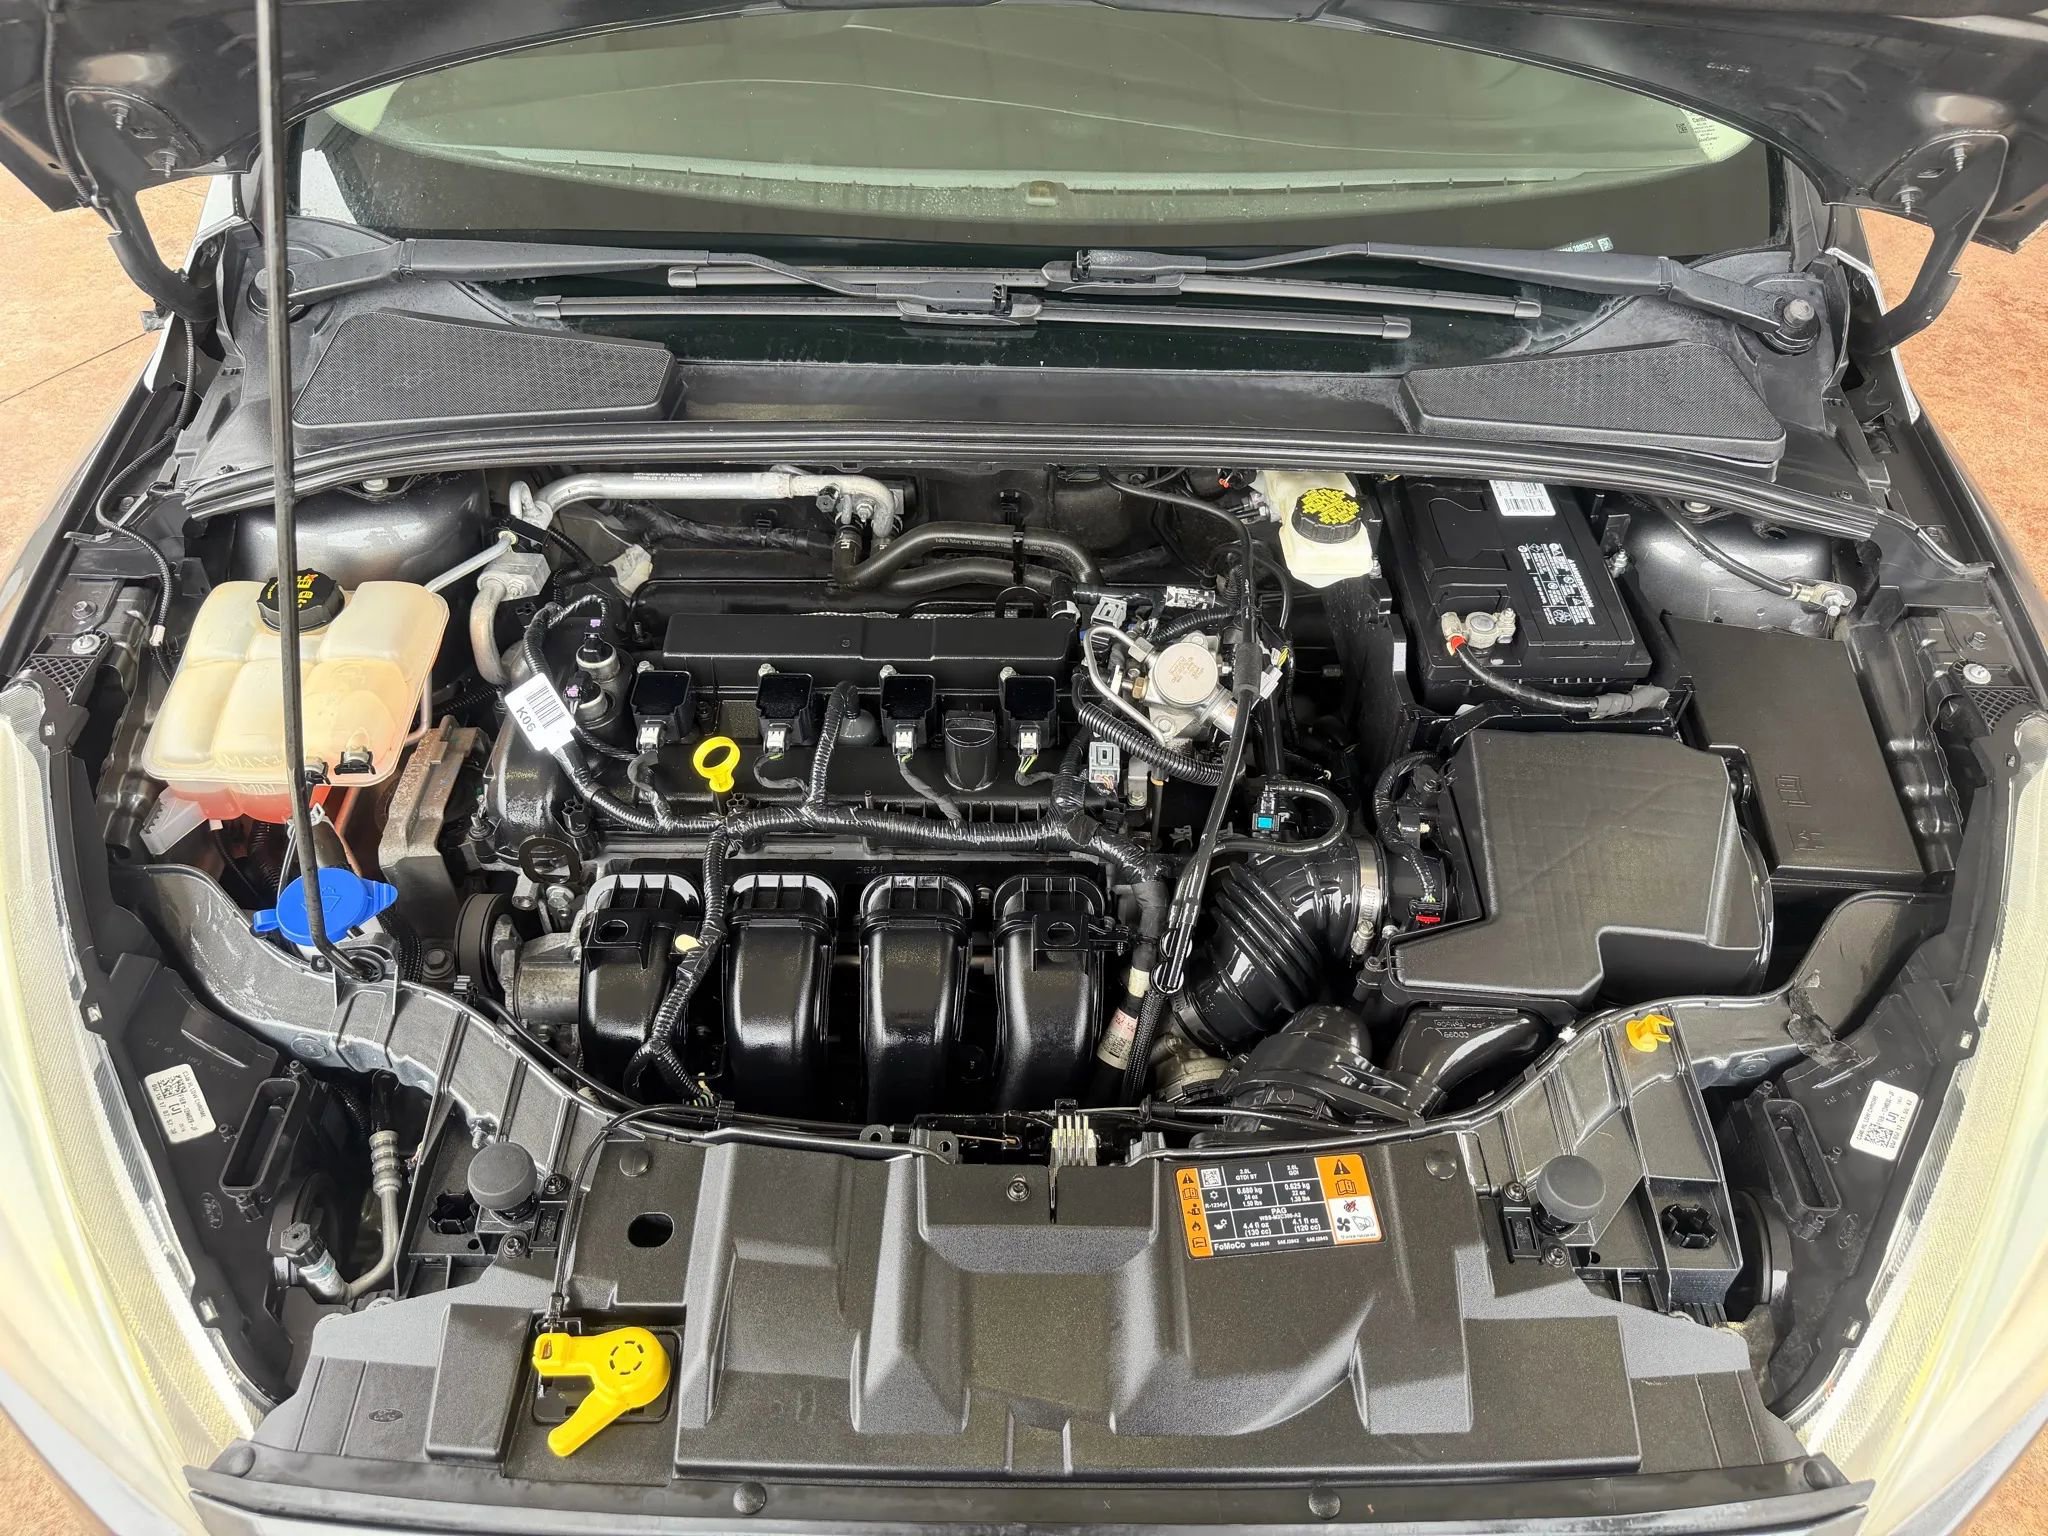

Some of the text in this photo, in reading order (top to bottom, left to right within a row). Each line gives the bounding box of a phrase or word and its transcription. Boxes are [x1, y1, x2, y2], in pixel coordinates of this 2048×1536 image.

[516, 706, 536, 732] K06
[1302, 1182, 1310, 1190] kg
[1271, 1207, 1287, 1215] PAG
[1245, 1229, 1259, 1237] (130
[1294, 1225, 1309, 1233] (120
[1214, 1242, 1245, 1250] FoMoCo
